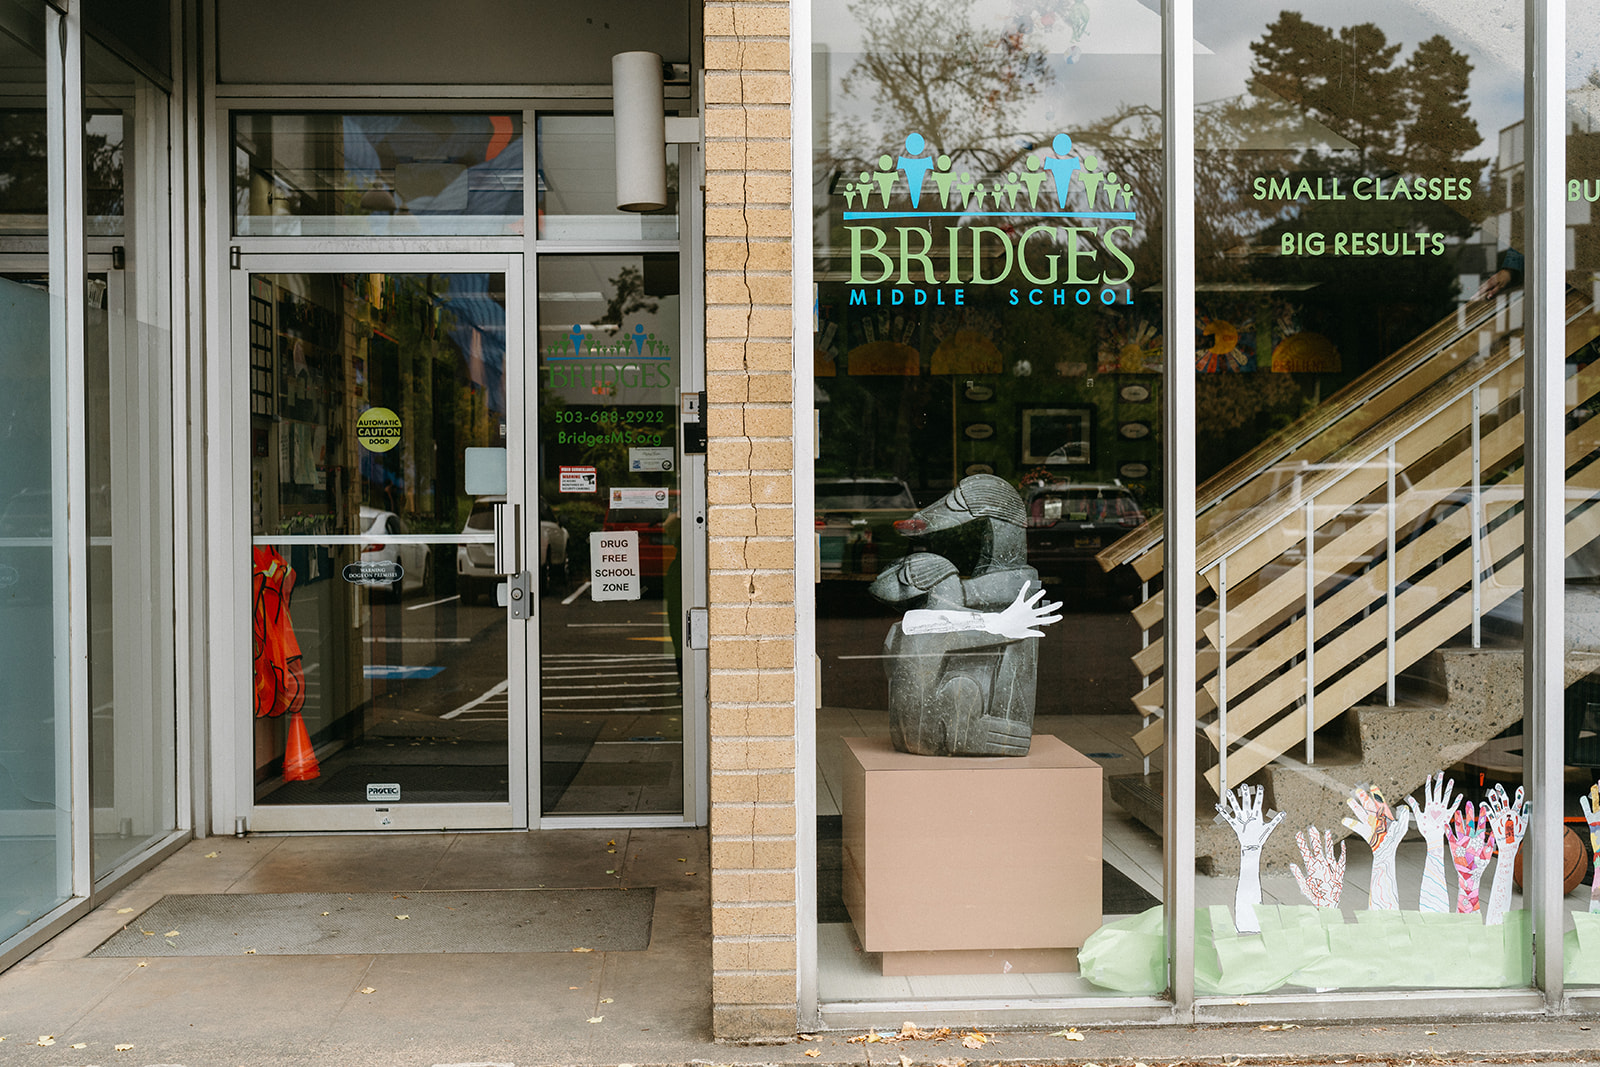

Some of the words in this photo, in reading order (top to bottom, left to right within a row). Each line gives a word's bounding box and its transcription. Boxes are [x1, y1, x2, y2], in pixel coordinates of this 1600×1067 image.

[1253, 177, 1346, 201] SMALL
[1352, 177, 1472, 201] CLASSES
[1567, 179, 1600, 202] BU
[1281, 232, 1325, 256] BIG
[1334, 232, 1445, 256] RESULTS
[843, 226, 1136, 286] BRIDGES
[849, 289, 965, 306] MIDDLE
[1009, 288, 1135, 306] SCHOOL
[549, 362, 671, 388] BRIDGES
[555, 410, 664, 423] 503-688-2922
[357, 427, 401, 436] CAUTION
[558, 431, 662, 447] BridgesMS.org
[600, 539, 629, 549] DRUG
[602, 554, 628, 563] FREE
[595, 568, 636, 577] SCHOOL
[602, 583, 629, 592] ZONE
